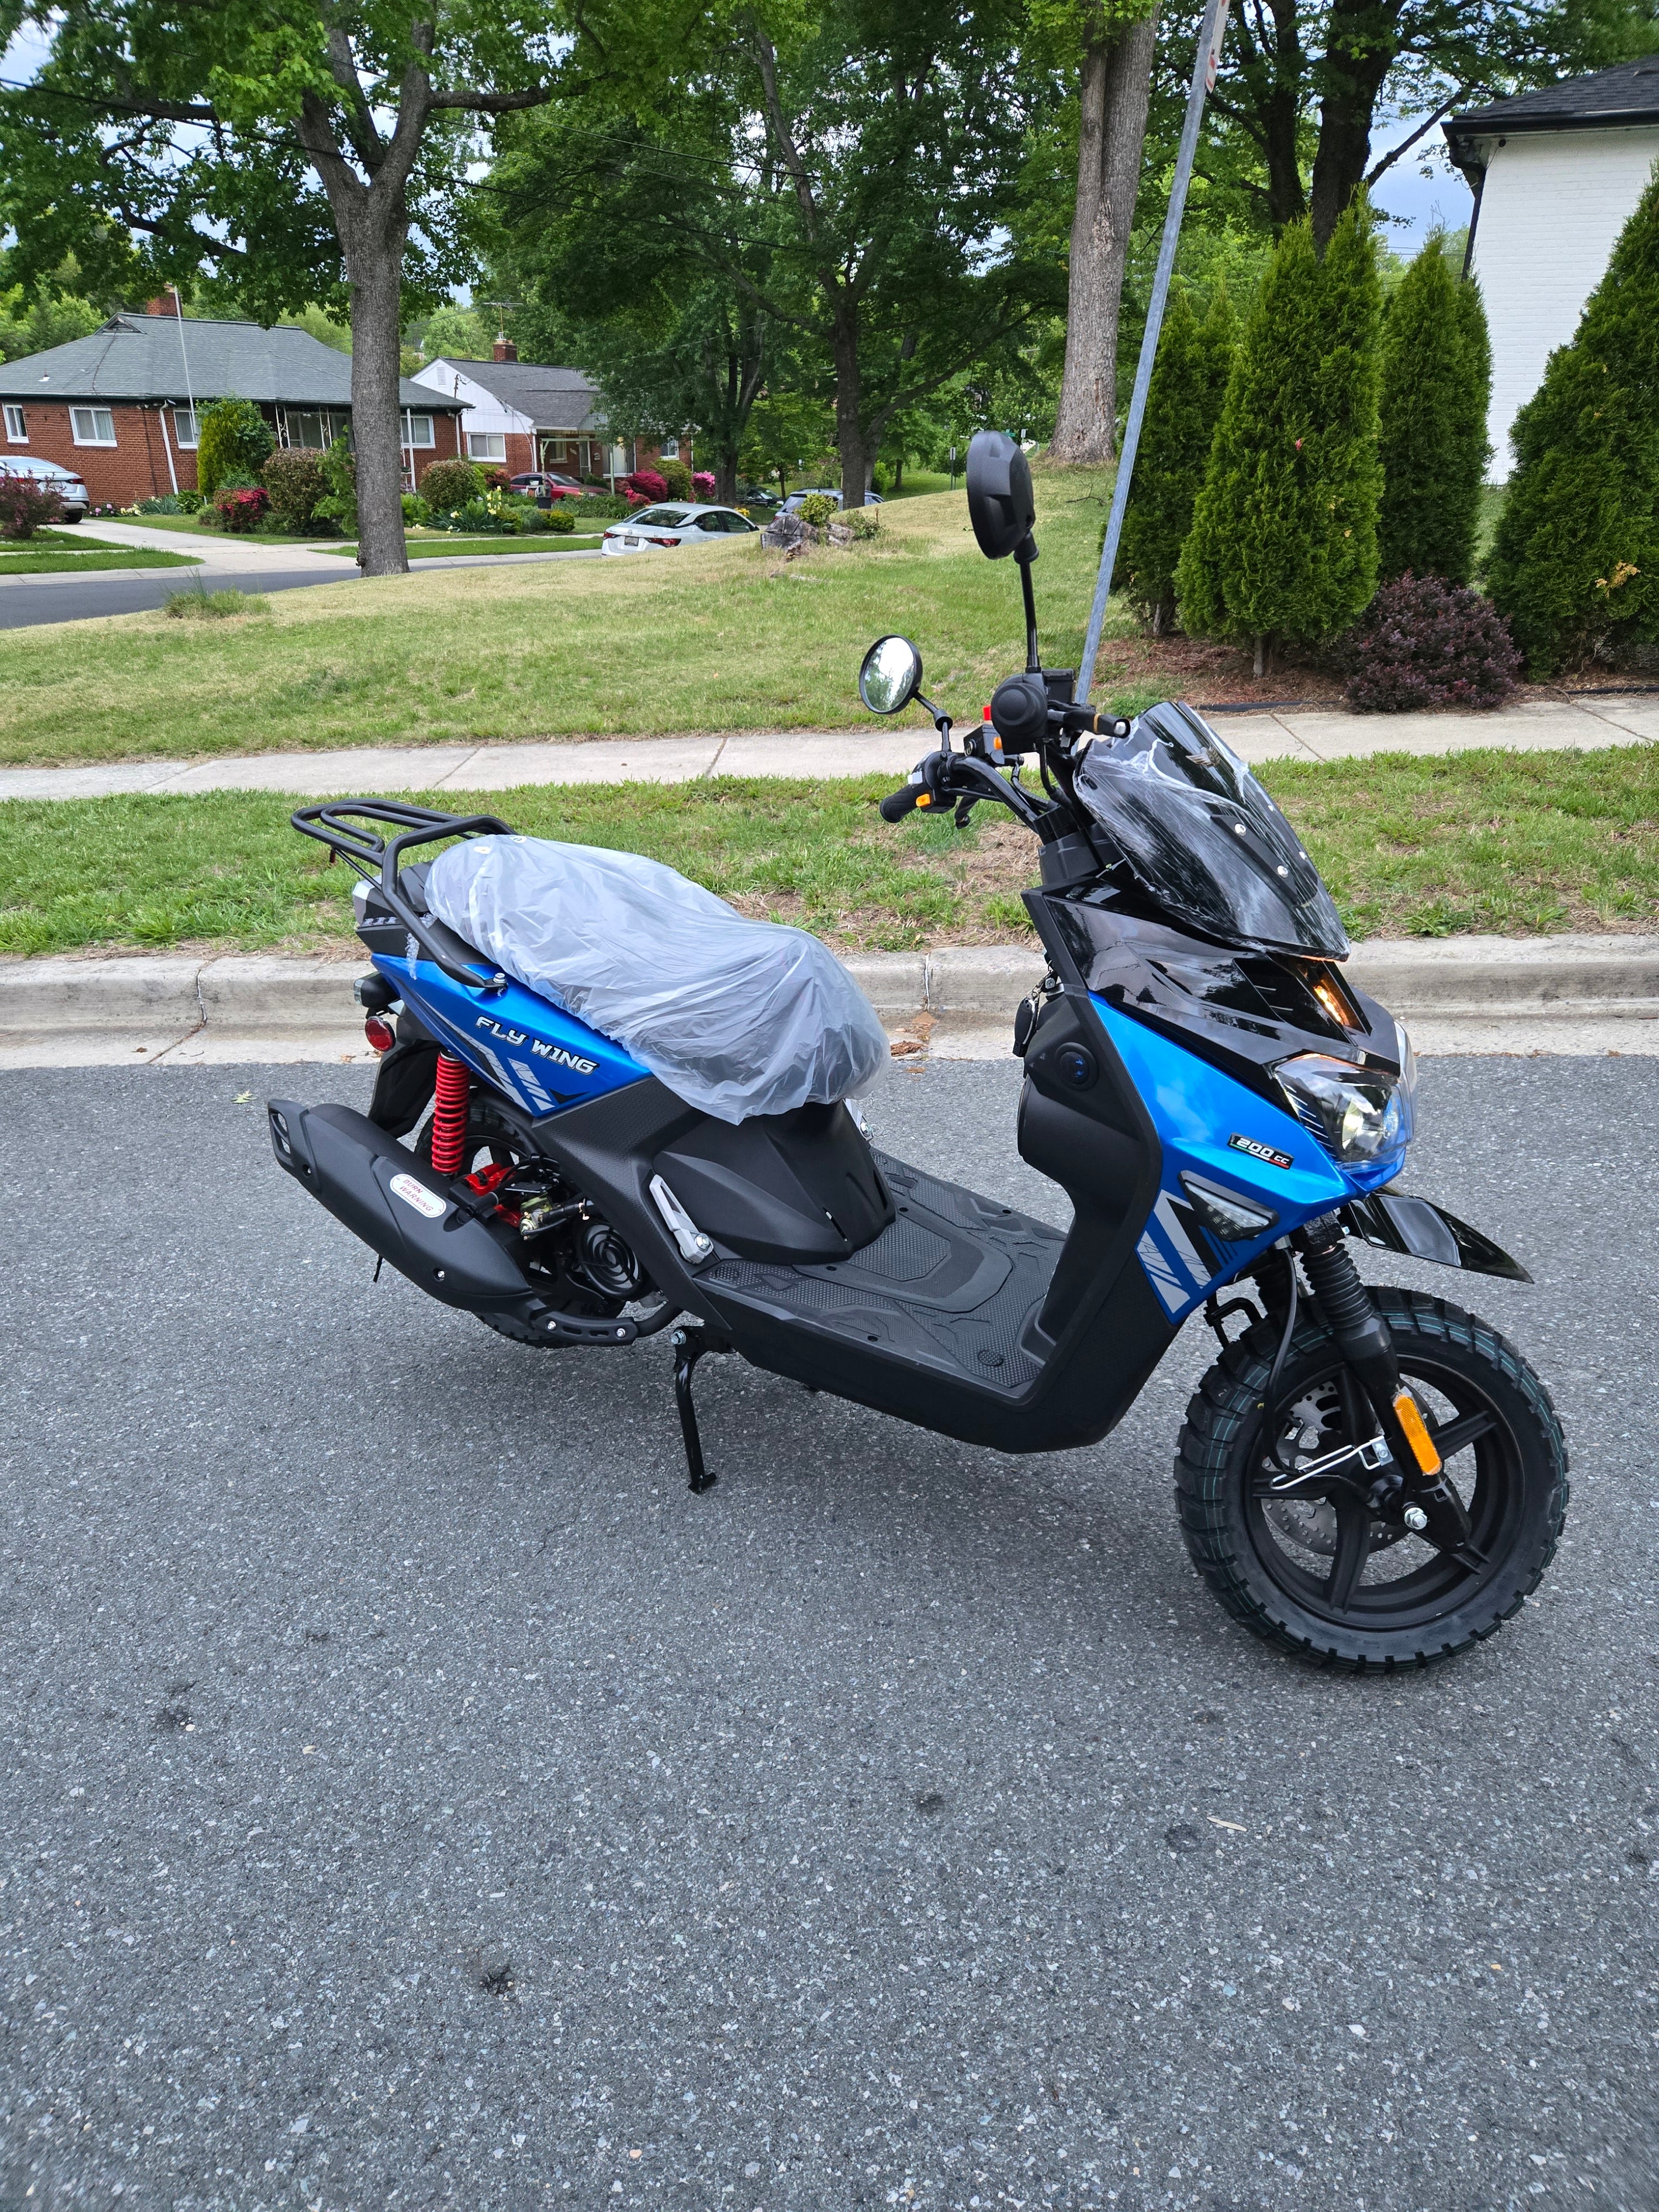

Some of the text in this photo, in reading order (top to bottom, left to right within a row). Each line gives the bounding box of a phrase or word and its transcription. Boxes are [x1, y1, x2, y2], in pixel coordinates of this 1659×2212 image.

[476, 1015, 599, 1075] FLY WING
[1237, 1138, 1274, 1157] 200
[403, 1179, 424, 1194] BURN
[399, 1186, 434, 1211] WARNING
